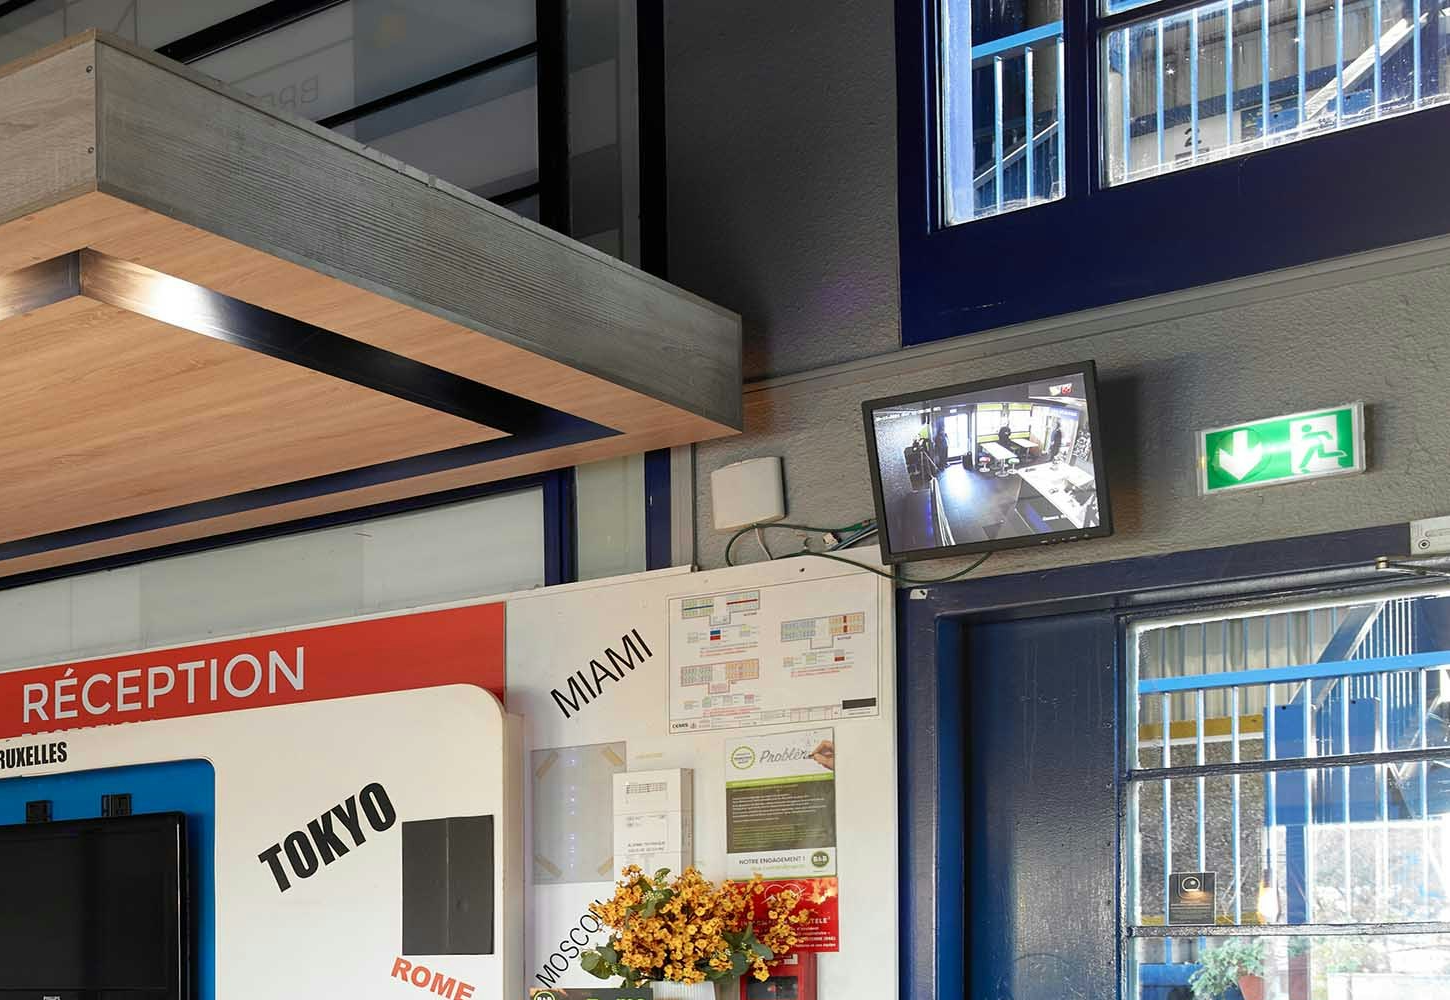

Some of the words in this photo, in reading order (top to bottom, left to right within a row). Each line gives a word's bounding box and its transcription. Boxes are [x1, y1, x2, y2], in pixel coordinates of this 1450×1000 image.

[23, 646, 304, 722] RÉCEPTION
[550, 628, 653, 719] MIAMI
[258, 782, 396, 892] TOKYO
